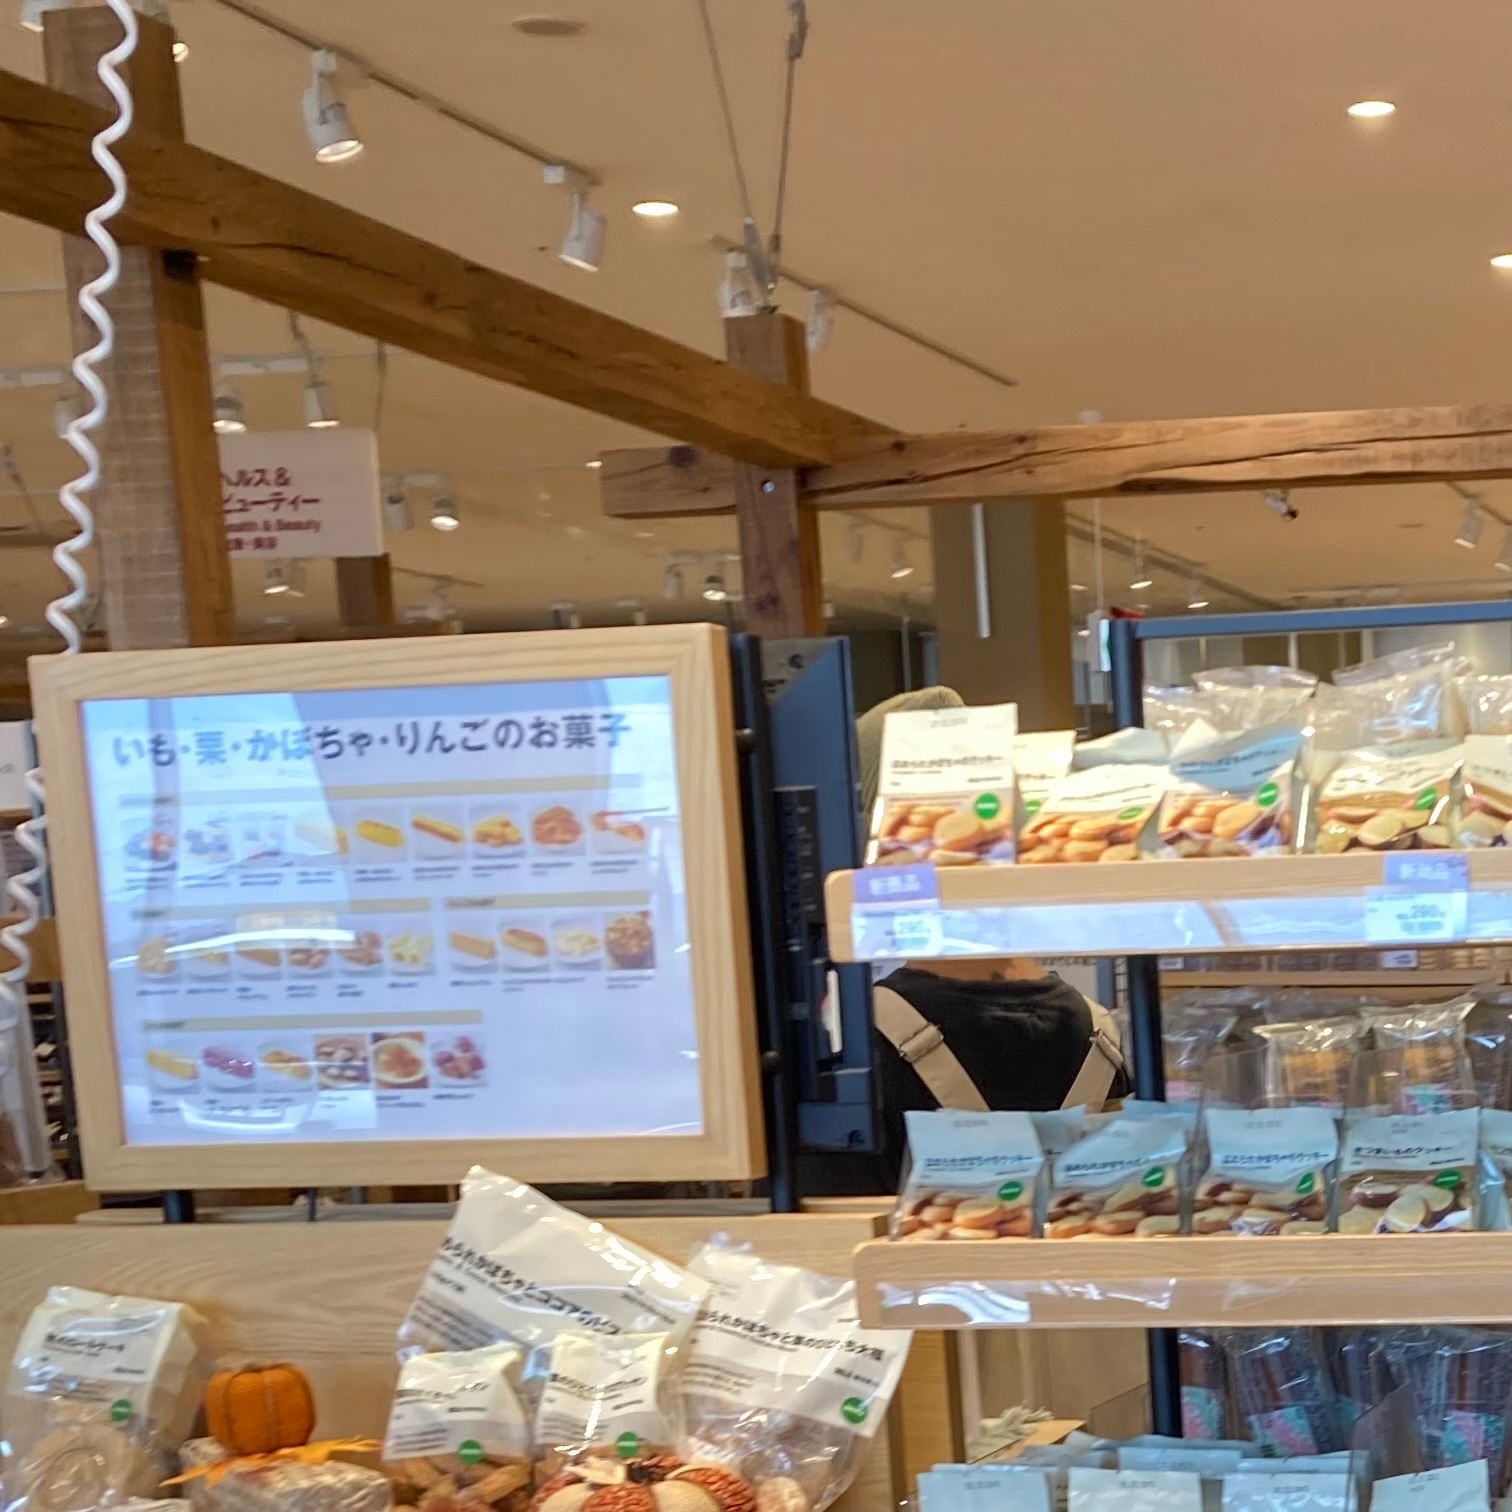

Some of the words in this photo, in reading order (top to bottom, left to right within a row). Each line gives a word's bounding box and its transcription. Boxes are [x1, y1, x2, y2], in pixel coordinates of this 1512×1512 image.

[112, 711, 632, 768] いも・栗・かぼちゃ・りんごのお菓子
